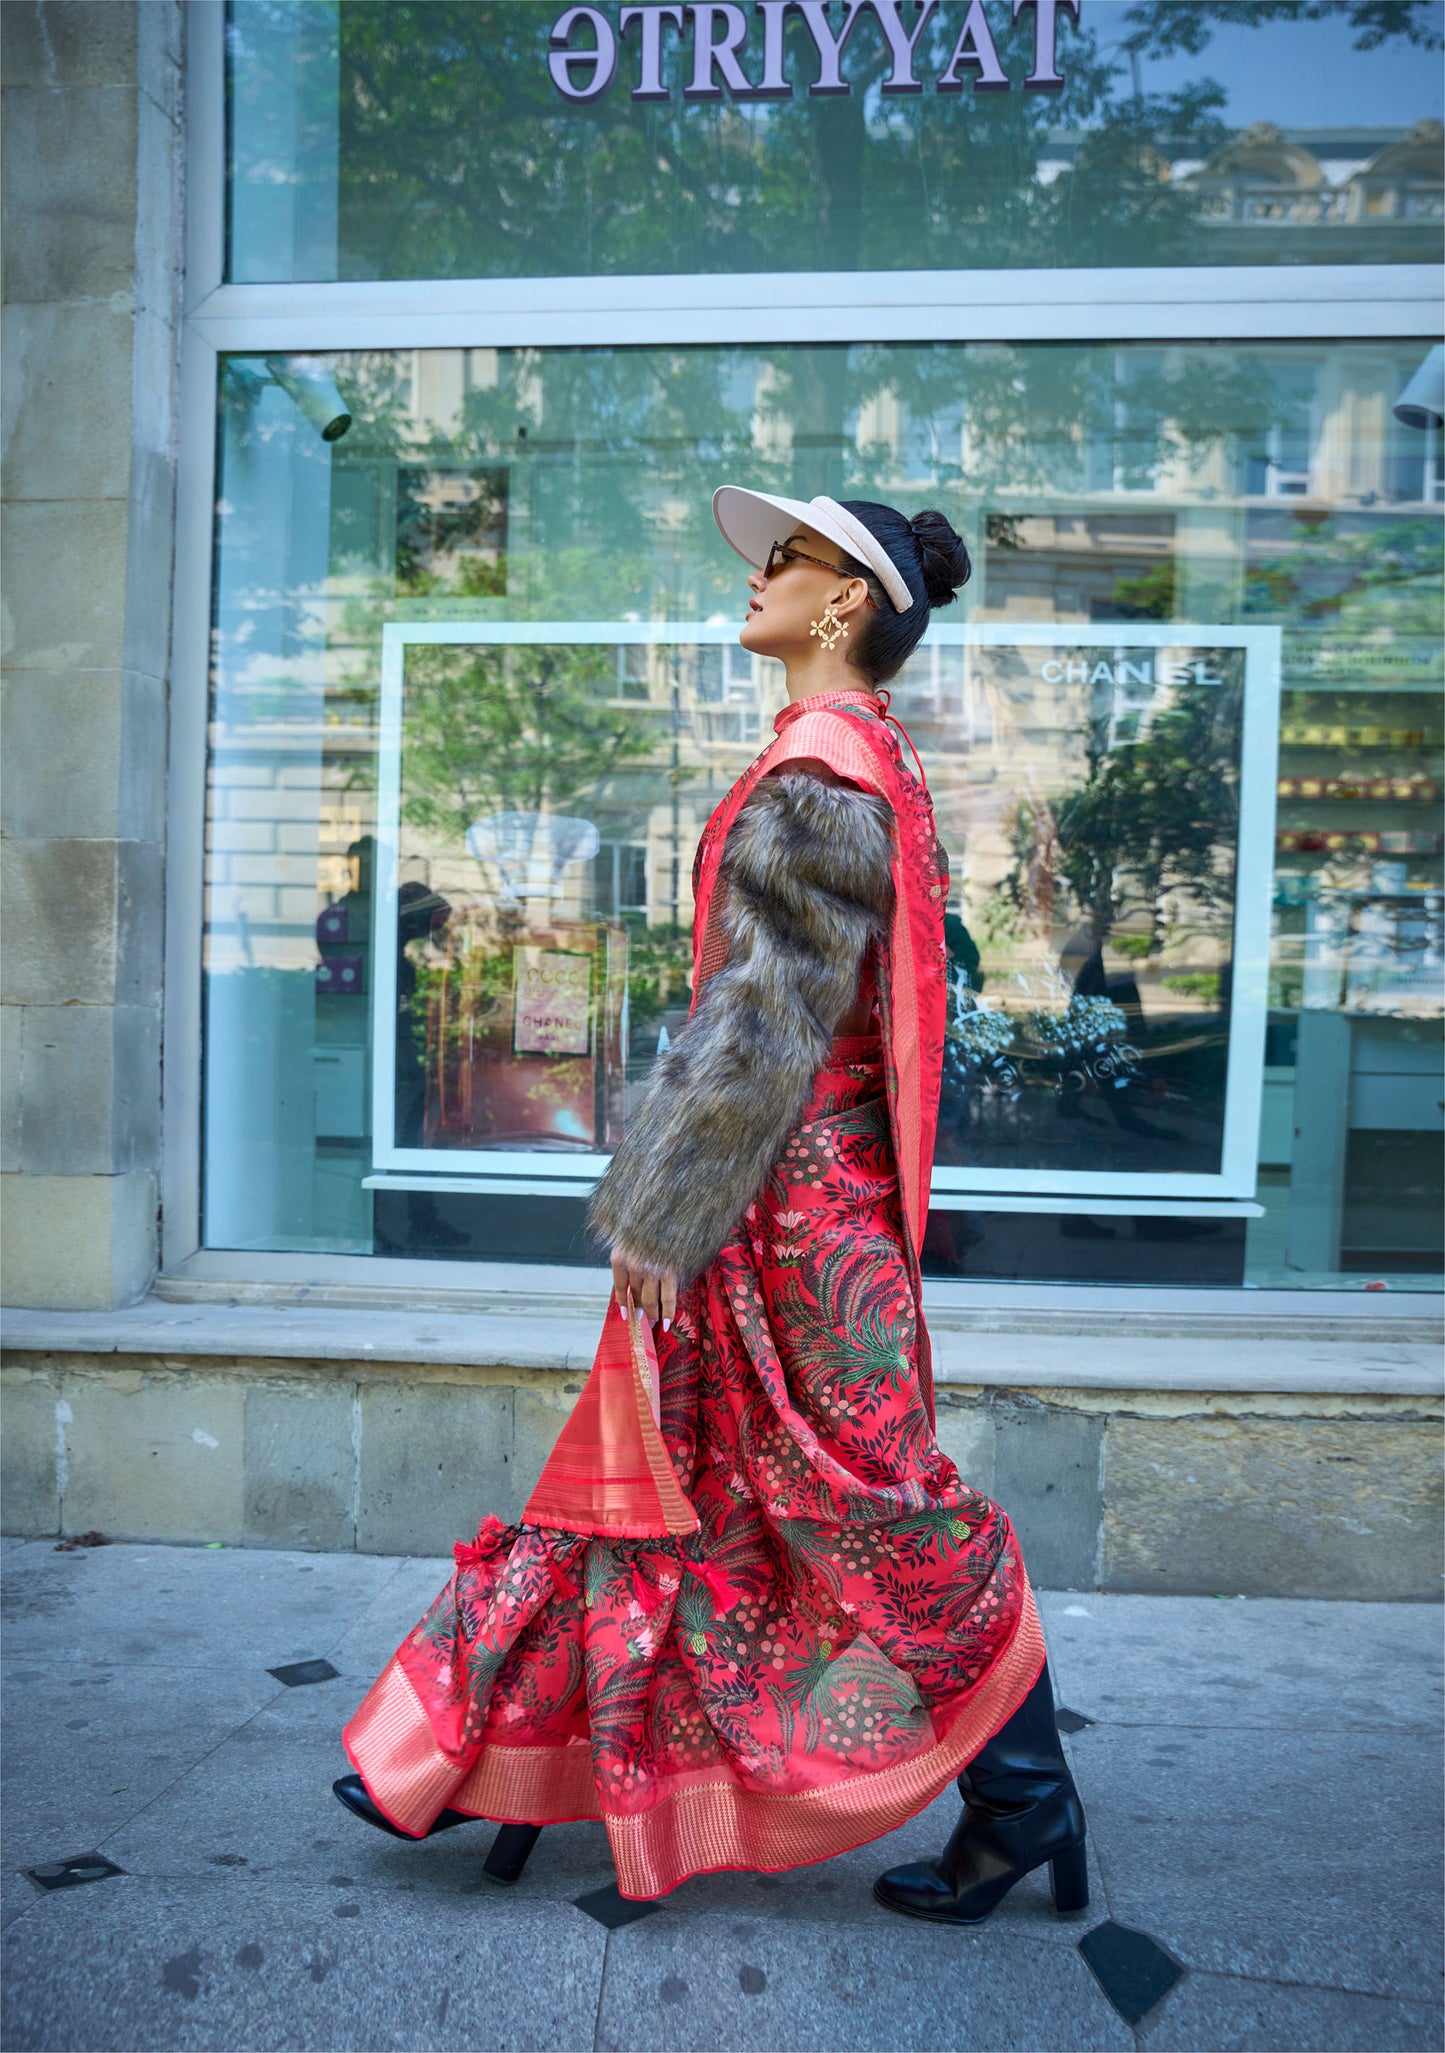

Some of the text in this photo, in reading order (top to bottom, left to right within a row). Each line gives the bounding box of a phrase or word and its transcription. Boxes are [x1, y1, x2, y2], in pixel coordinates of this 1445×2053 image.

[548, 0, 1080, 98] ƏTRIYYAT
[1041, 660, 1222, 686] CHANEL
[523, 1016, 581, 1030] CHANEL
